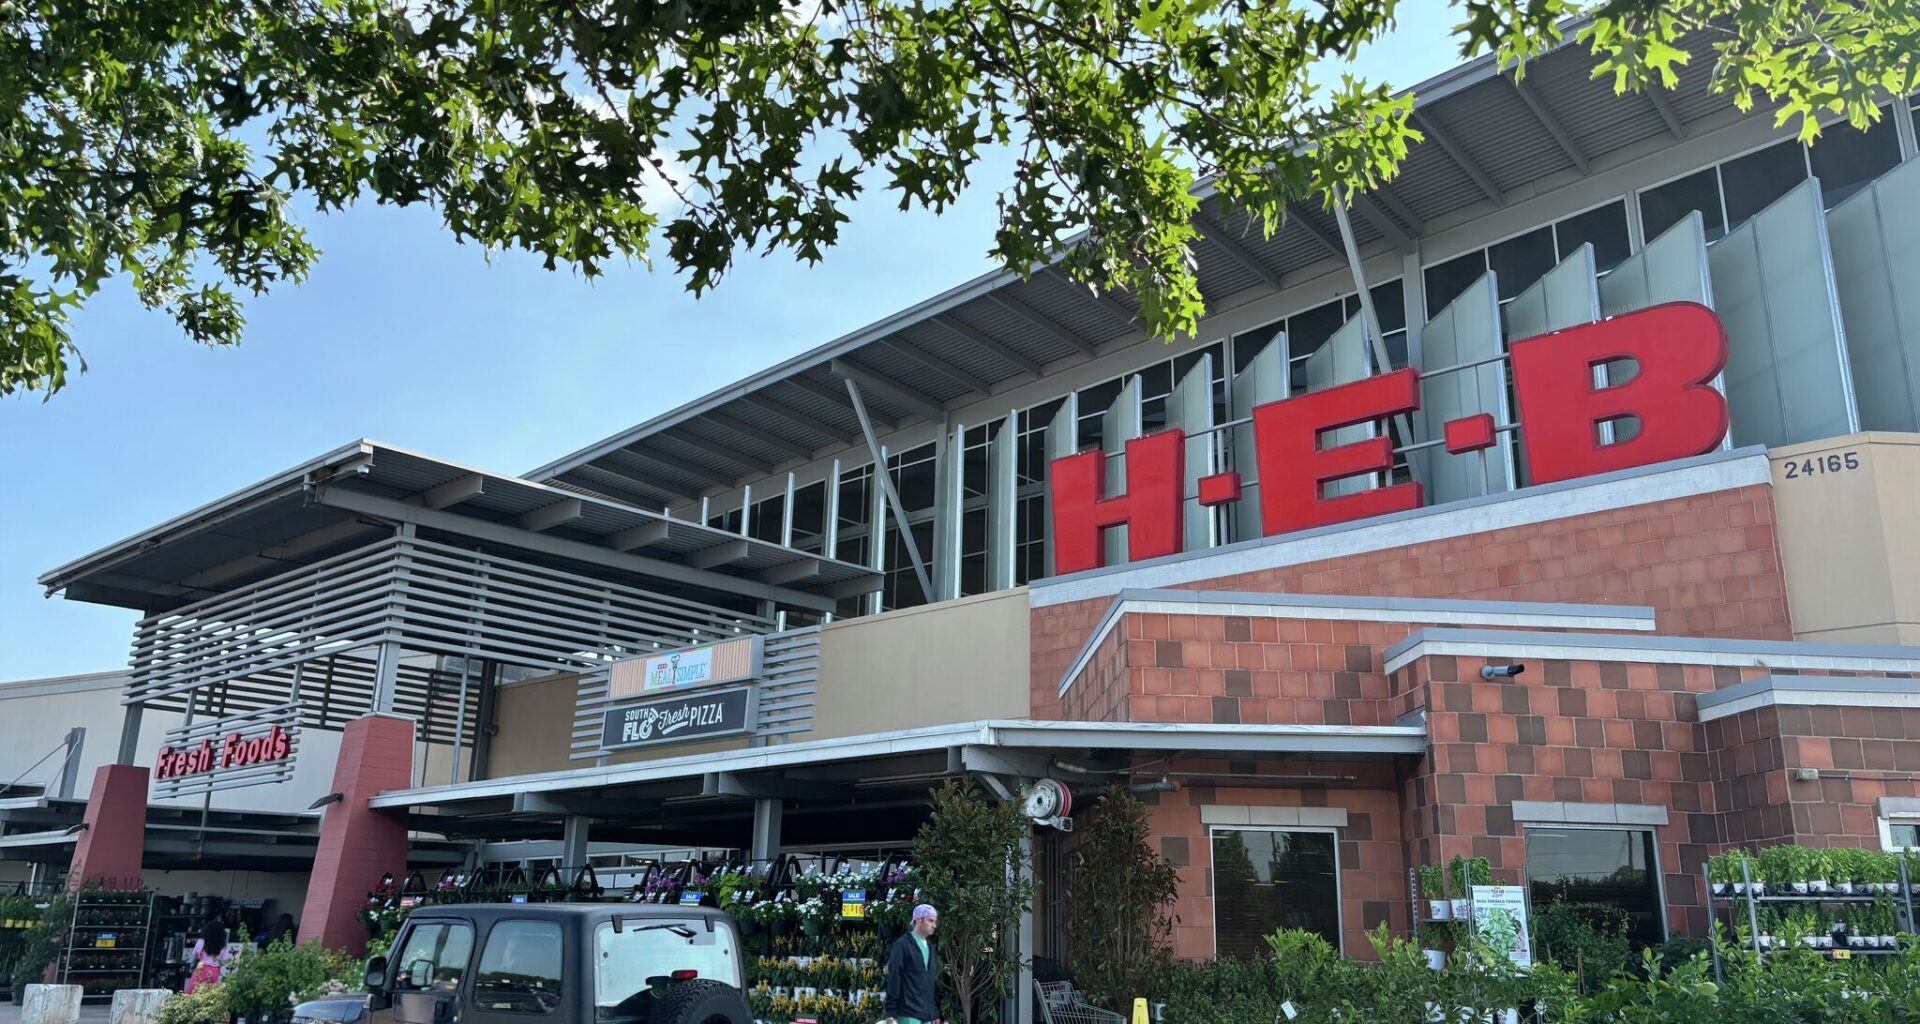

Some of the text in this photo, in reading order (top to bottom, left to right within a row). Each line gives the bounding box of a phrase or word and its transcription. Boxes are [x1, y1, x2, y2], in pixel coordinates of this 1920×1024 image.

[1784, 451, 1859, 479] 24165
[650, 663, 706, 686] MEAL SIMPLE
[624, 708, 649, 721] SOUTH
[658, 703, 723, 731] Fresh PIZZA
[622, 720, 652, 742] FLO
[154, 725, 290, 779] Fresh Foods
